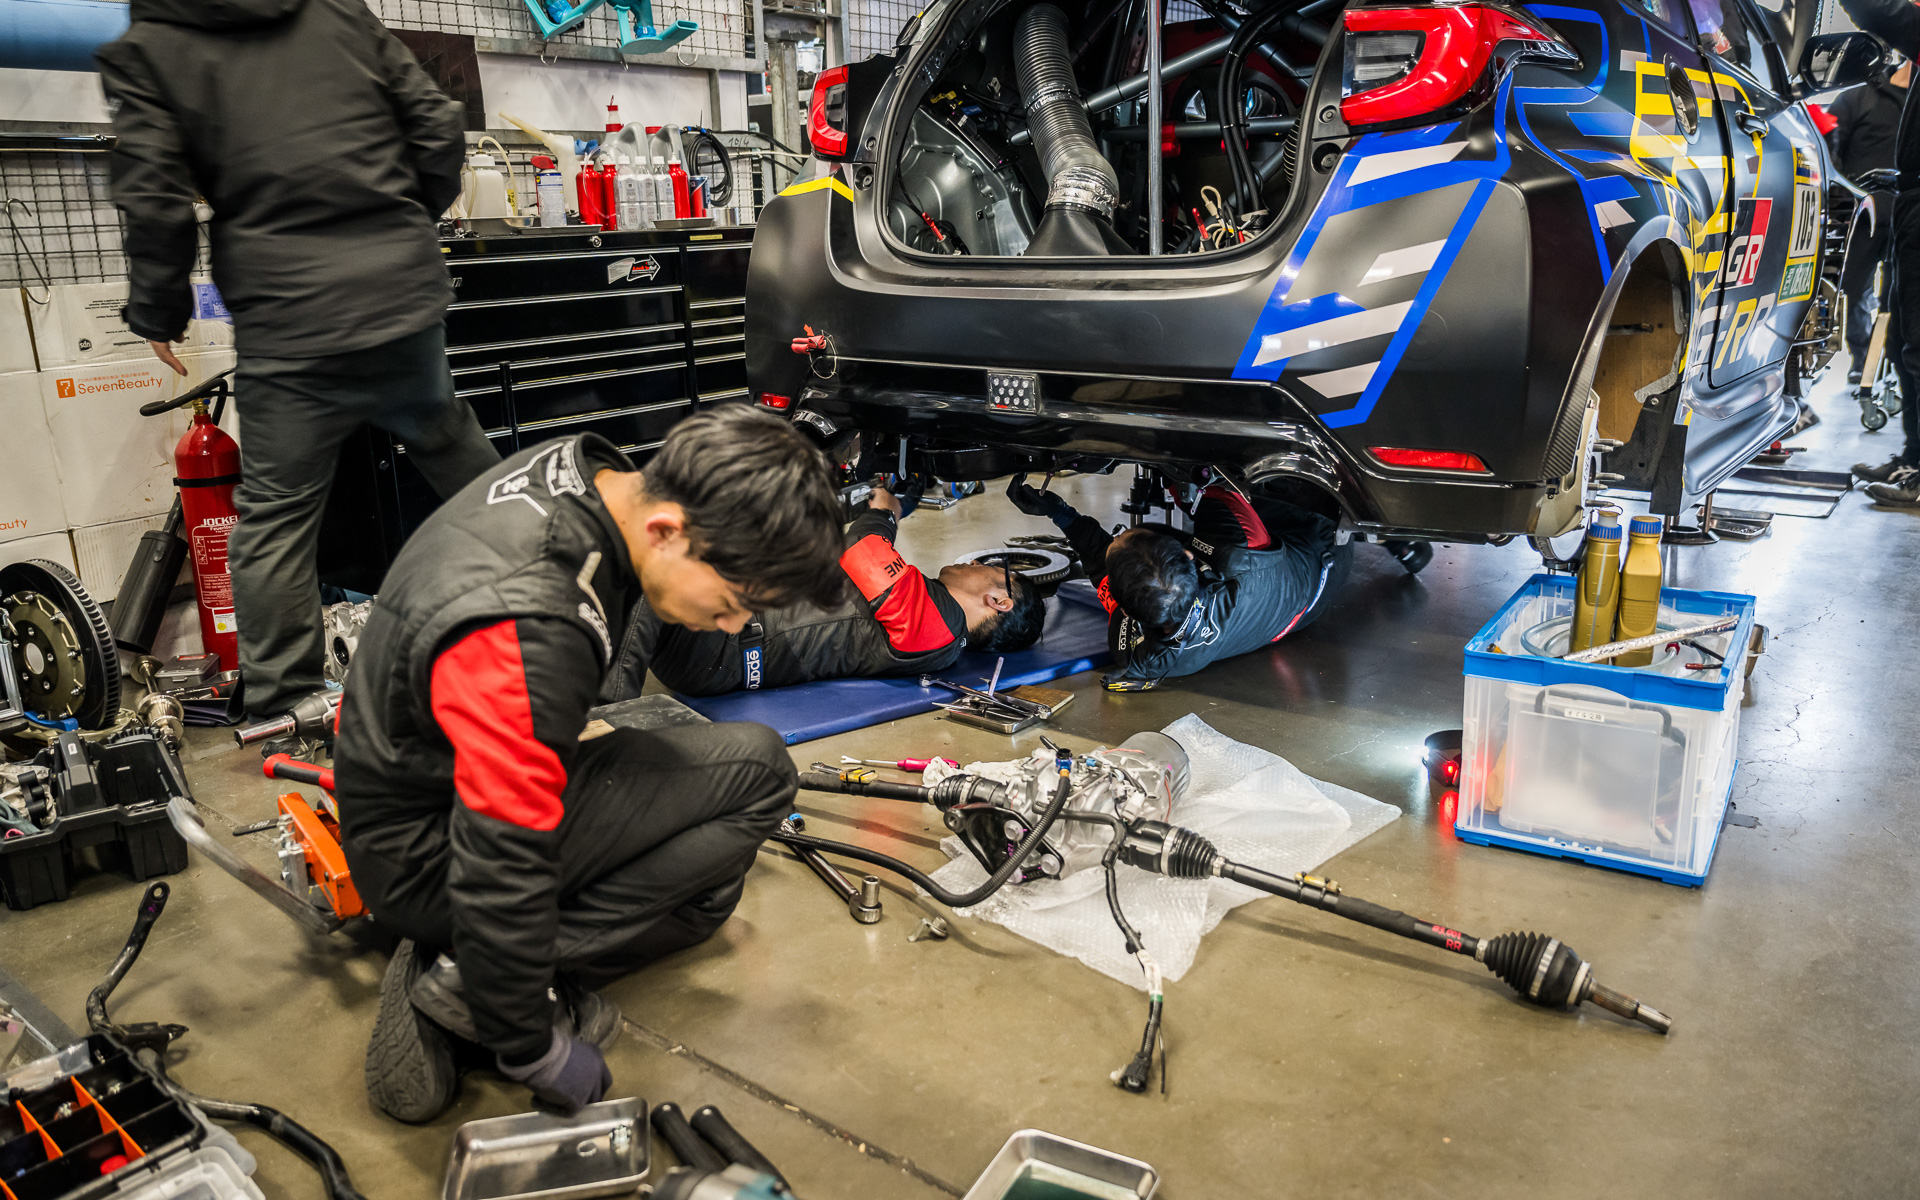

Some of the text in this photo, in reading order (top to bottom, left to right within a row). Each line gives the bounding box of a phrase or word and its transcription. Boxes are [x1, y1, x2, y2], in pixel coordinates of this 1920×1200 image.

[1718, 234, 1764, 283] GR
[78, 377, 163, 395] SevenBeauty
[1445, 938, 1462, 952] RR
